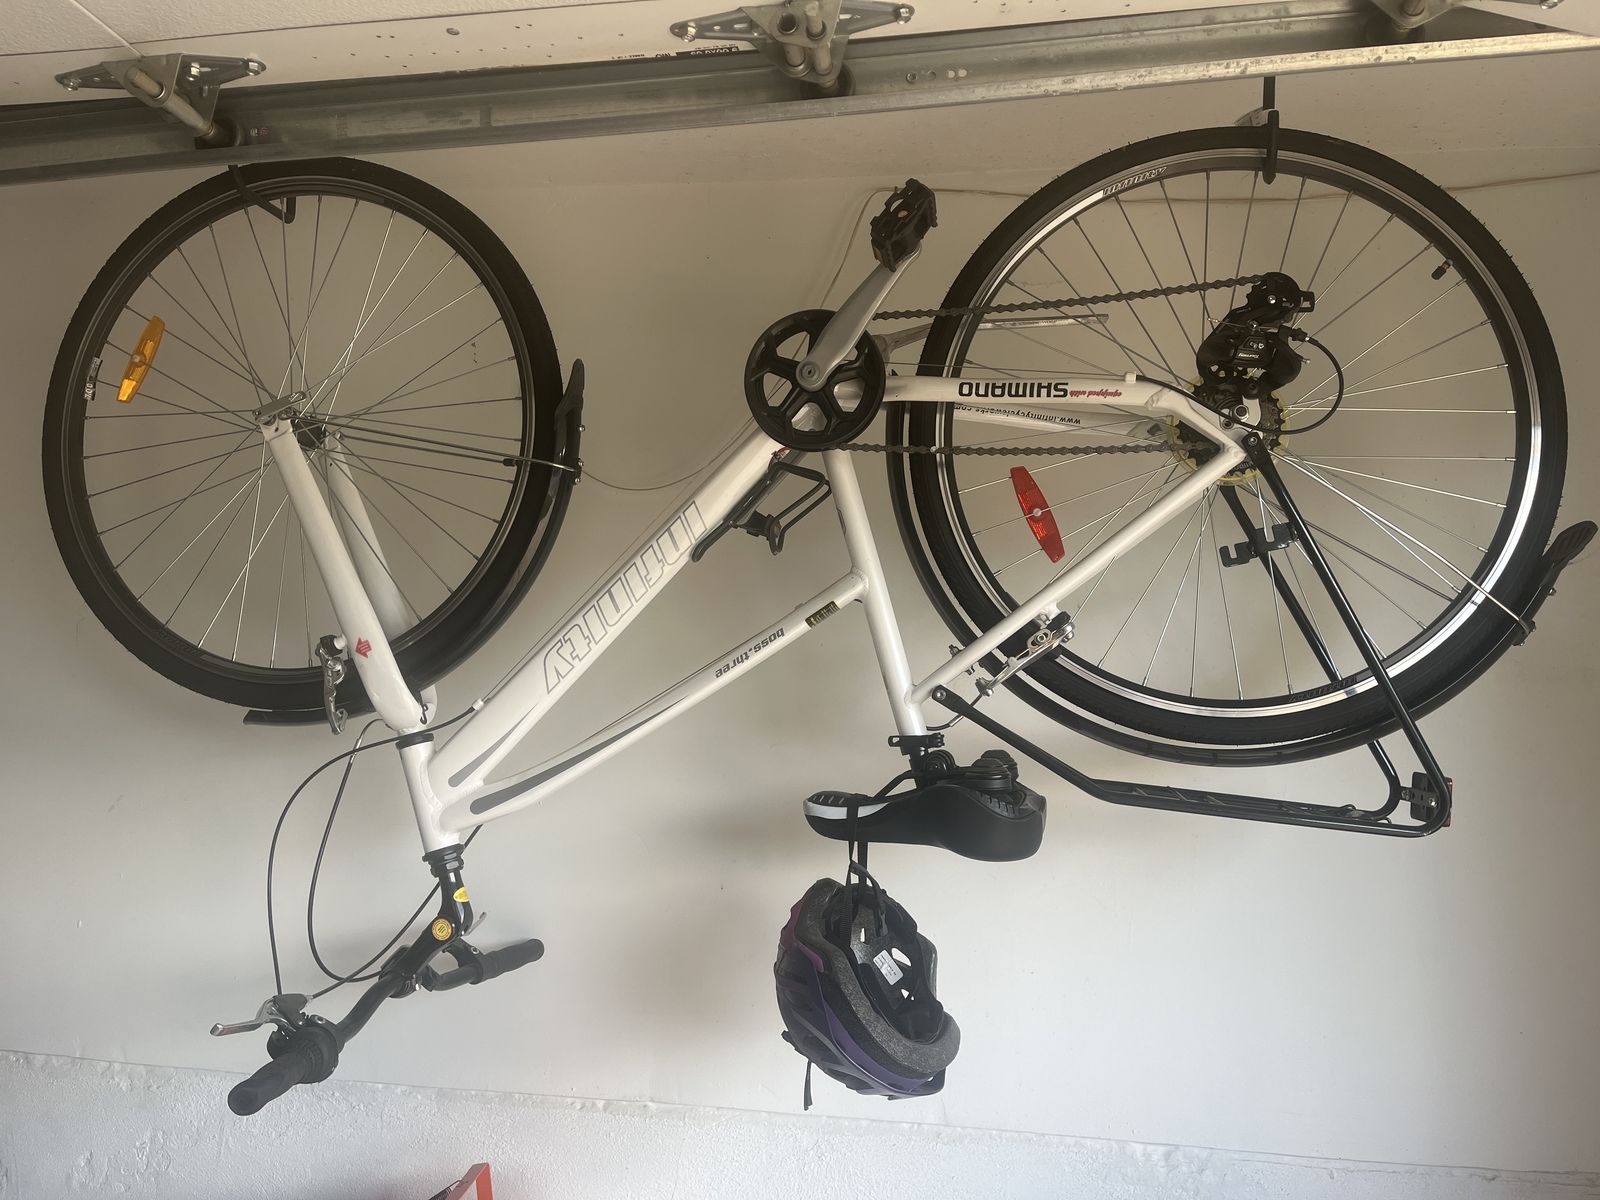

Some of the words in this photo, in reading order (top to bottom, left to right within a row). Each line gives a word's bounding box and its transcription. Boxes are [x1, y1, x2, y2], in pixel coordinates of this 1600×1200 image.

[958, 381, 1069, 398] SHIMANO
[1069, 389, 1087, 398] with
[1087, 388, 1122, 399] equipped
[954, 403, 1081, 425] www.infinitycycleworkscom
[714, 627, 785, 679] boss.three
